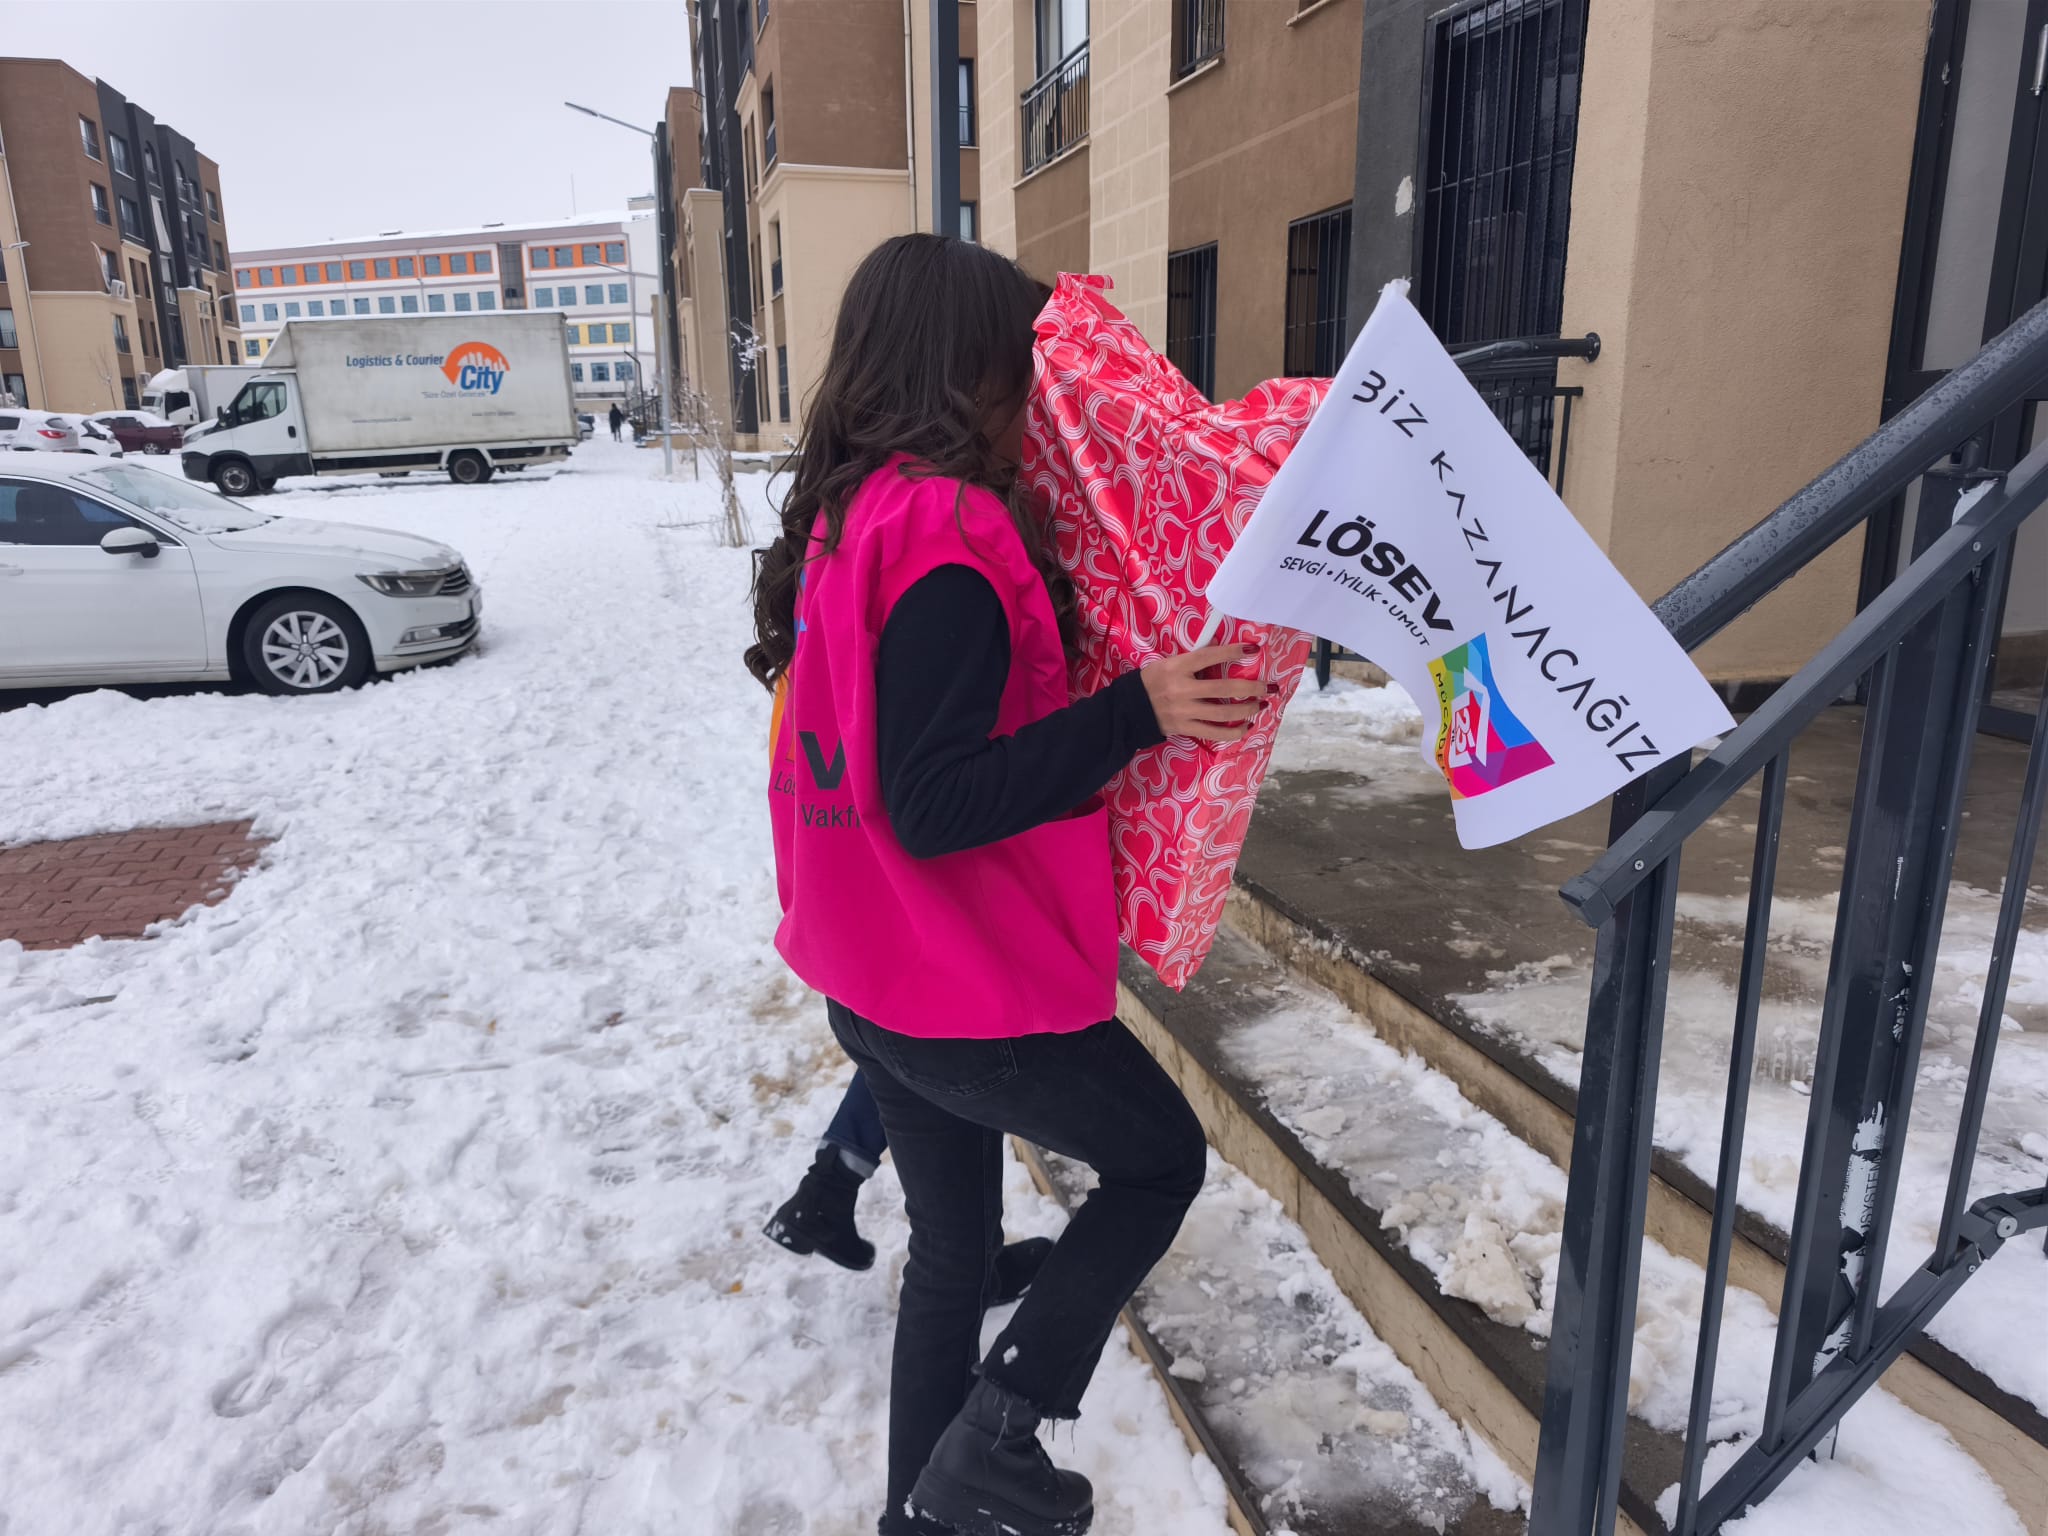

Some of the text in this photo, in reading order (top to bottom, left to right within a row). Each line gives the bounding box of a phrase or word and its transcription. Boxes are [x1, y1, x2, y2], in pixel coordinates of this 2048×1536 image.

[346, 354, 444, 368] Logistics & Courier
[460, 365, 505, 395] City
[1296, 509, 1455, 631] LÖSEV
[1279, 556, 1430, 646] SEVGİ İYİLİK UMUT
